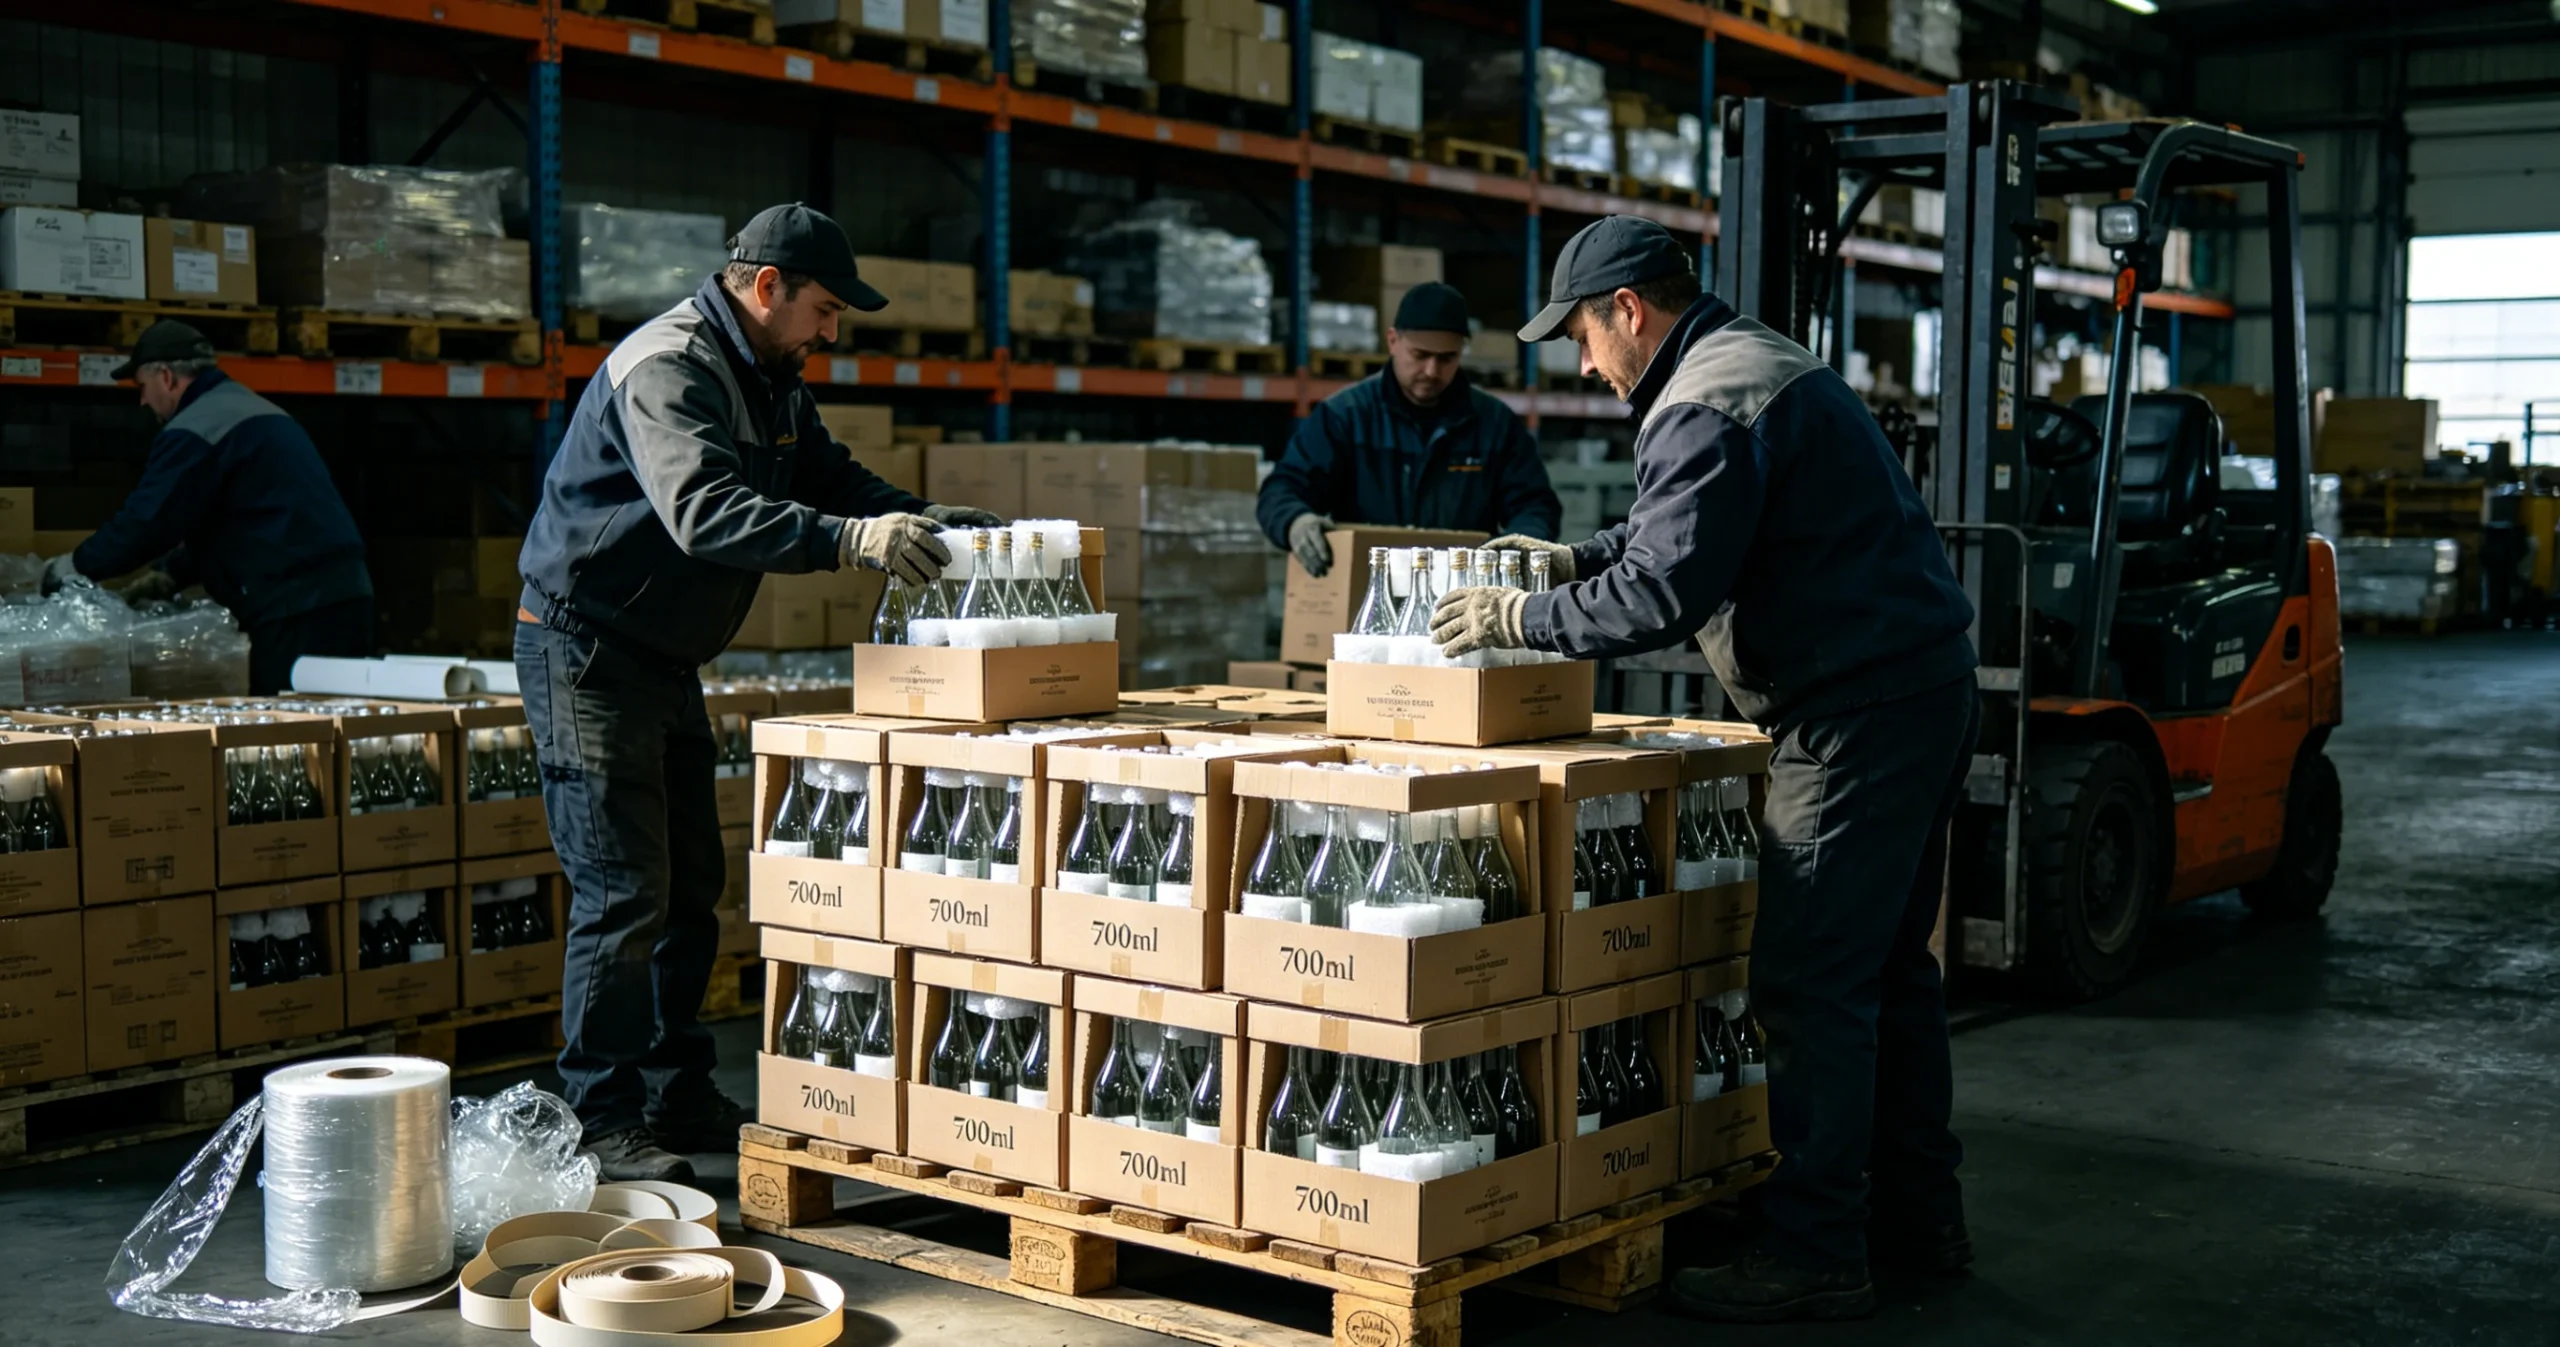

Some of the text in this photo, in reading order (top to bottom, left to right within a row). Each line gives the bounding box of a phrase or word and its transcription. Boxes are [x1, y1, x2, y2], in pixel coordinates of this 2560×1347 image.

[788, 880, 842, 908] 700ml
[929, 898, 988, 928] 700ml
[1092, 920, 1158, 952] 700ml
[1280, 946, 1355, 982] 700ml
[801, 1085, 856, 1118] 700ml
[953, 1116, 1014, 1150] 700ml
[1120, 1151, 1186, 1186] 700ml
[1295, 1185, 1370, 1225] 700ml
